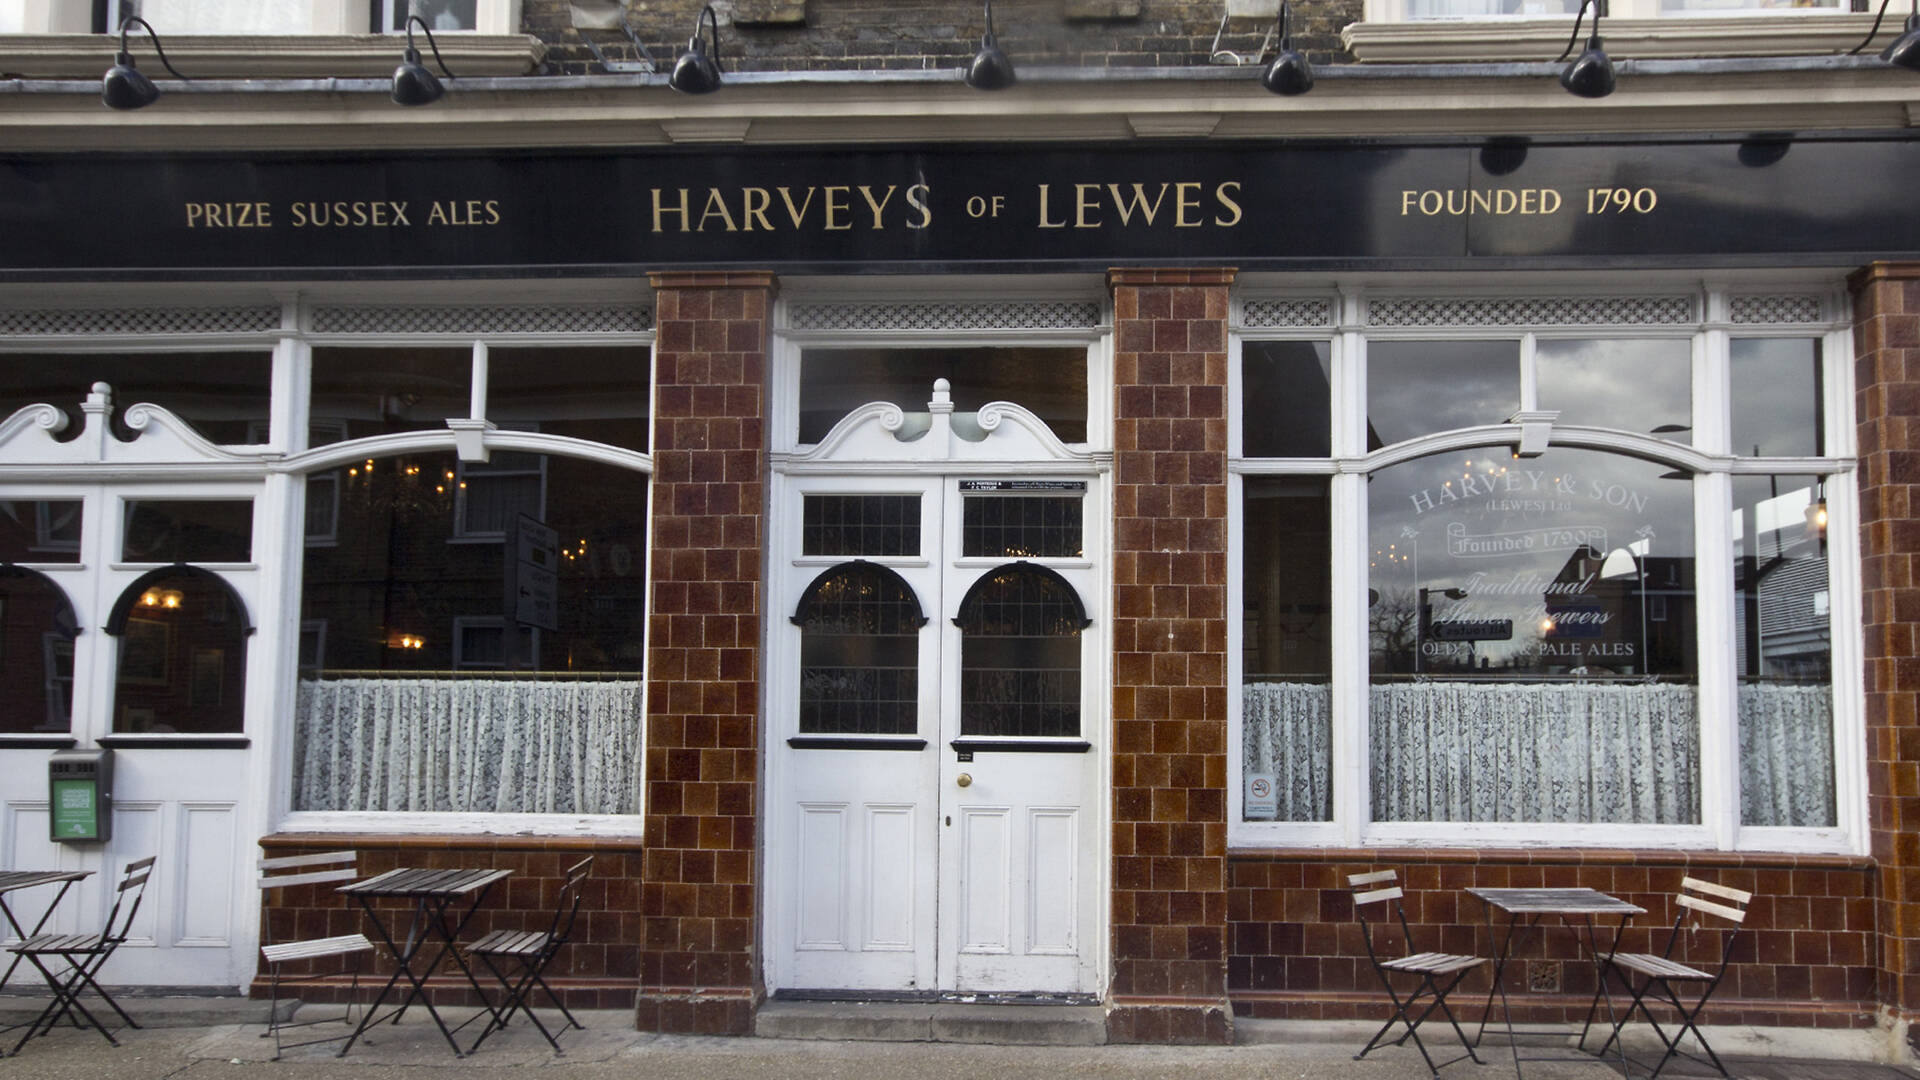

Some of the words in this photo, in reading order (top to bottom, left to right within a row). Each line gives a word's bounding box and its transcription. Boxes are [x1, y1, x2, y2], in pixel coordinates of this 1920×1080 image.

[185, 202, 272, 228] PRIZE
[291, 202, 411, 227] SUSSEX
[428, 200, 501, 226] ALES
[651, 184, 932, 232] HARVEYS
[966, 195, 1005, 218] OF
[1037, 181, 1243, 230] LEWES
[1401, 190, 1563, 216] FOUNDED
[1586, 188, 1657, 215] 1790
[1409, 470, 1543, 514] HARVEY
[1556, 473, 1576, 495] &
[1590, 479, 1649, 514] SON
[1455, 536, 1534, 553] Founded
[1543, 529, 1588, 547] 1790
[1459, 572, 1595, 594] Traditional
[1540, 643, 1582, 656] PALE
[1588, 643, 1635, 656] ALES
